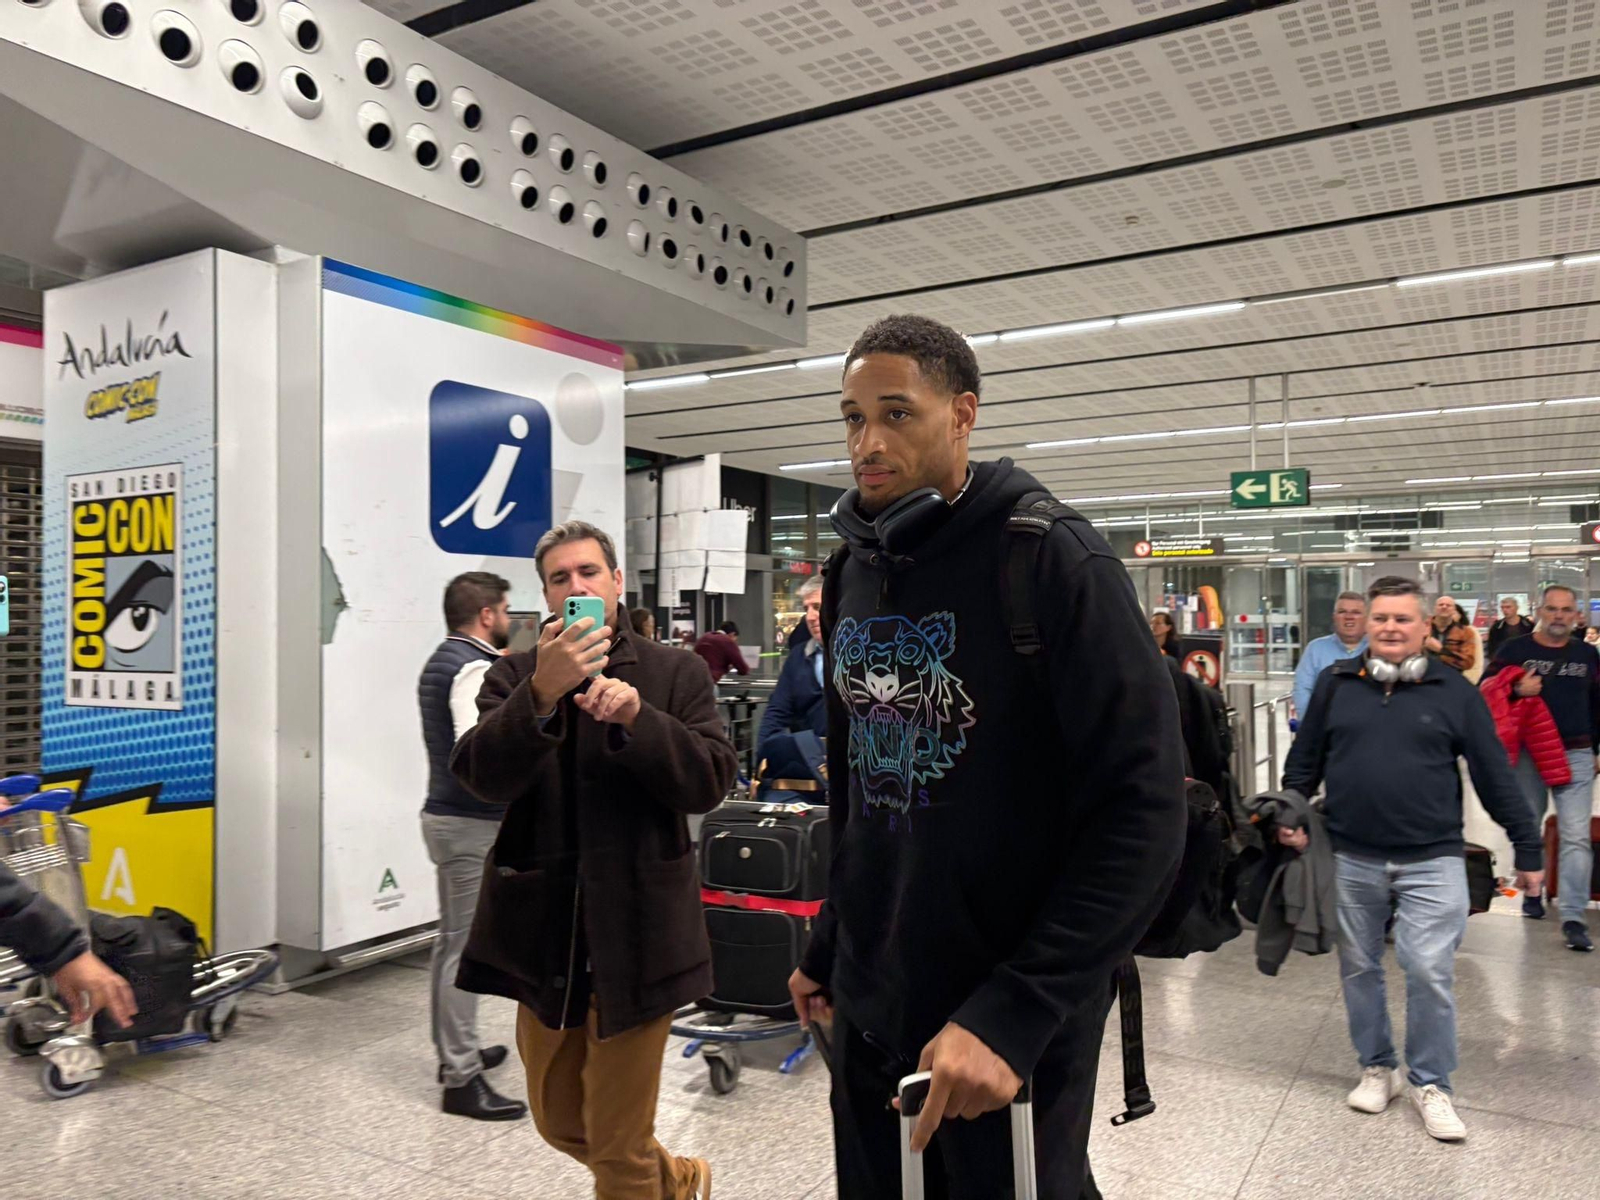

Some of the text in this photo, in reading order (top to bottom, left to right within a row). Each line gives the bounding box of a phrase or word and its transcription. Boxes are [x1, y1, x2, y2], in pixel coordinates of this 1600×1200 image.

[71, 472, 176, 498] SAN DIEGO
[107, 494, 174, 554] CON
[73, 502, 106, 669] COMIC
[71, 674, 176, 702] MÁLAGA
